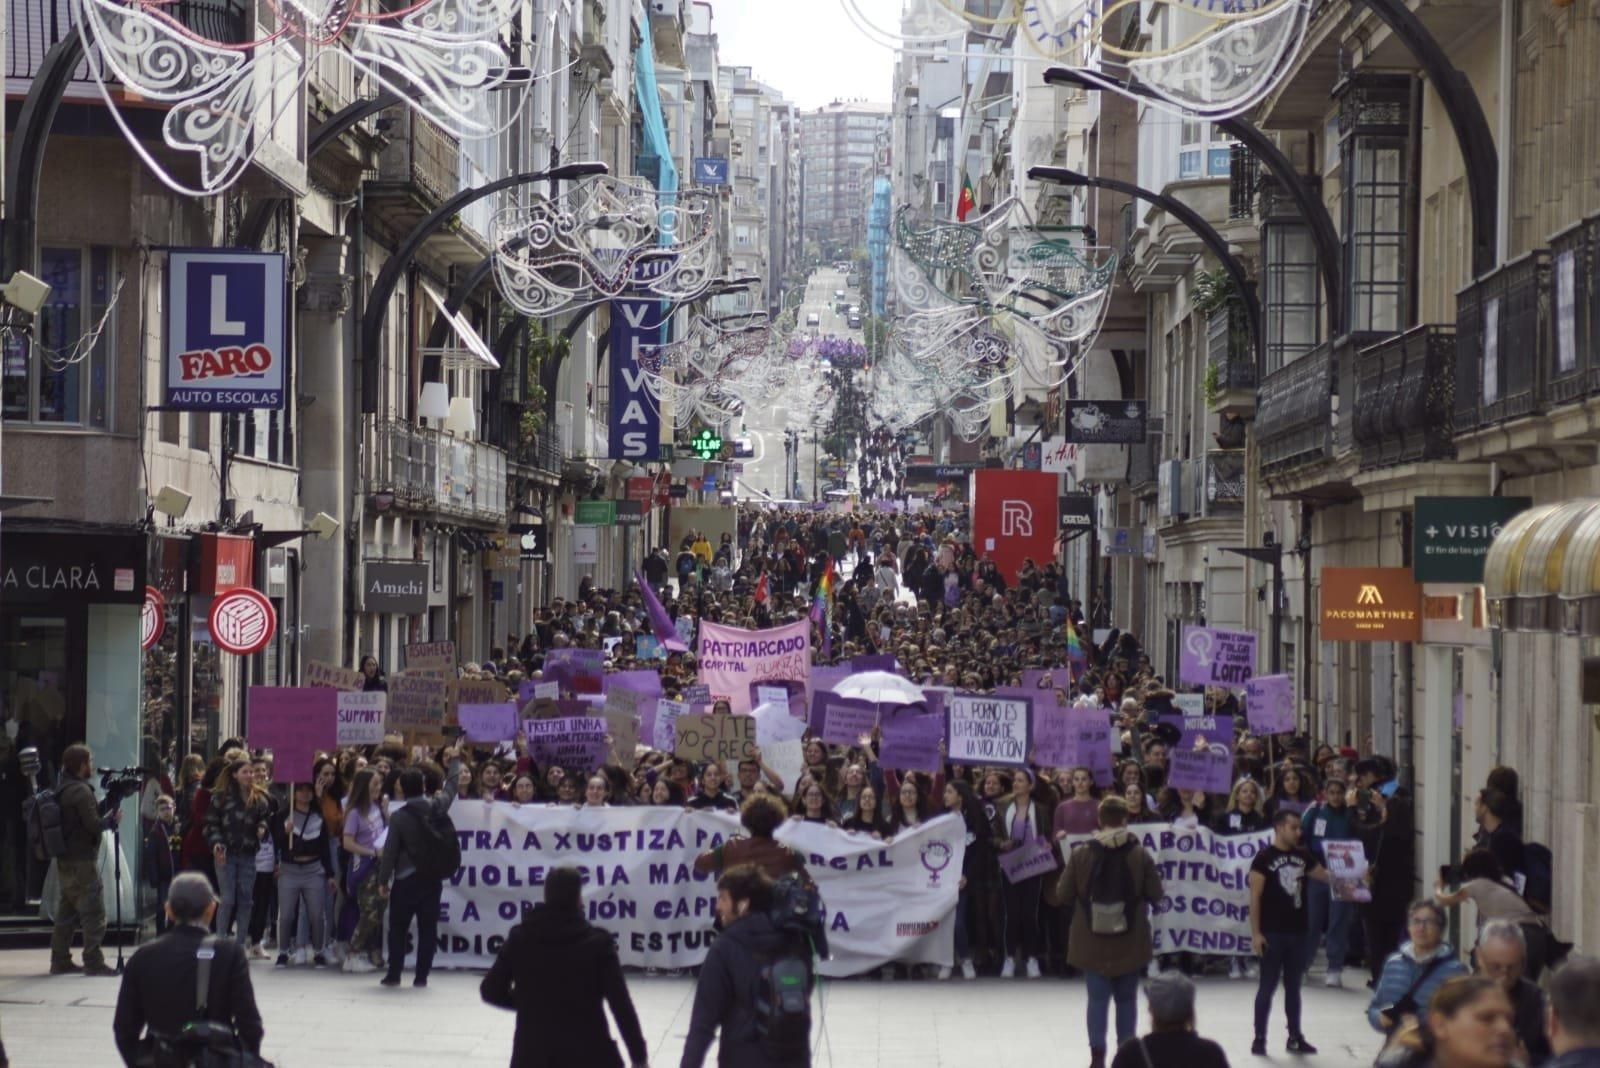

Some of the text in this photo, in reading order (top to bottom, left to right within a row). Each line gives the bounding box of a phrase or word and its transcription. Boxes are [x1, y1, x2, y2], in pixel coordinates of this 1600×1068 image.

[210, 275, 246, 336] L
[178, 345, 272, 381] FARO
[620, 304, 649, 456] VIVAS
[172, 391, 278, 404] AUTO ESCOLAS
[2, 563, 100, 589] A CLARÁ
[703, 636, 805, 657] PATRIARCADO
[705, 660, 747, 672] CAPITAL
[1211, 663, 1252, 683] LOITA
[338, 709, 383, 724] SUPPORT
[972, 702, 1001, 720] PORNO
[456, 829, 512, 851] TRA
[523, 831, 542, 850] A
[554, 828, 685, 852] XUSTIZA
[450, 864, 629, 887] VIOLECIA
[462, 901, 480, 923] A
[654, 897, 717, 919] CAPI
[631, 930, 717, 954] ESTUD
